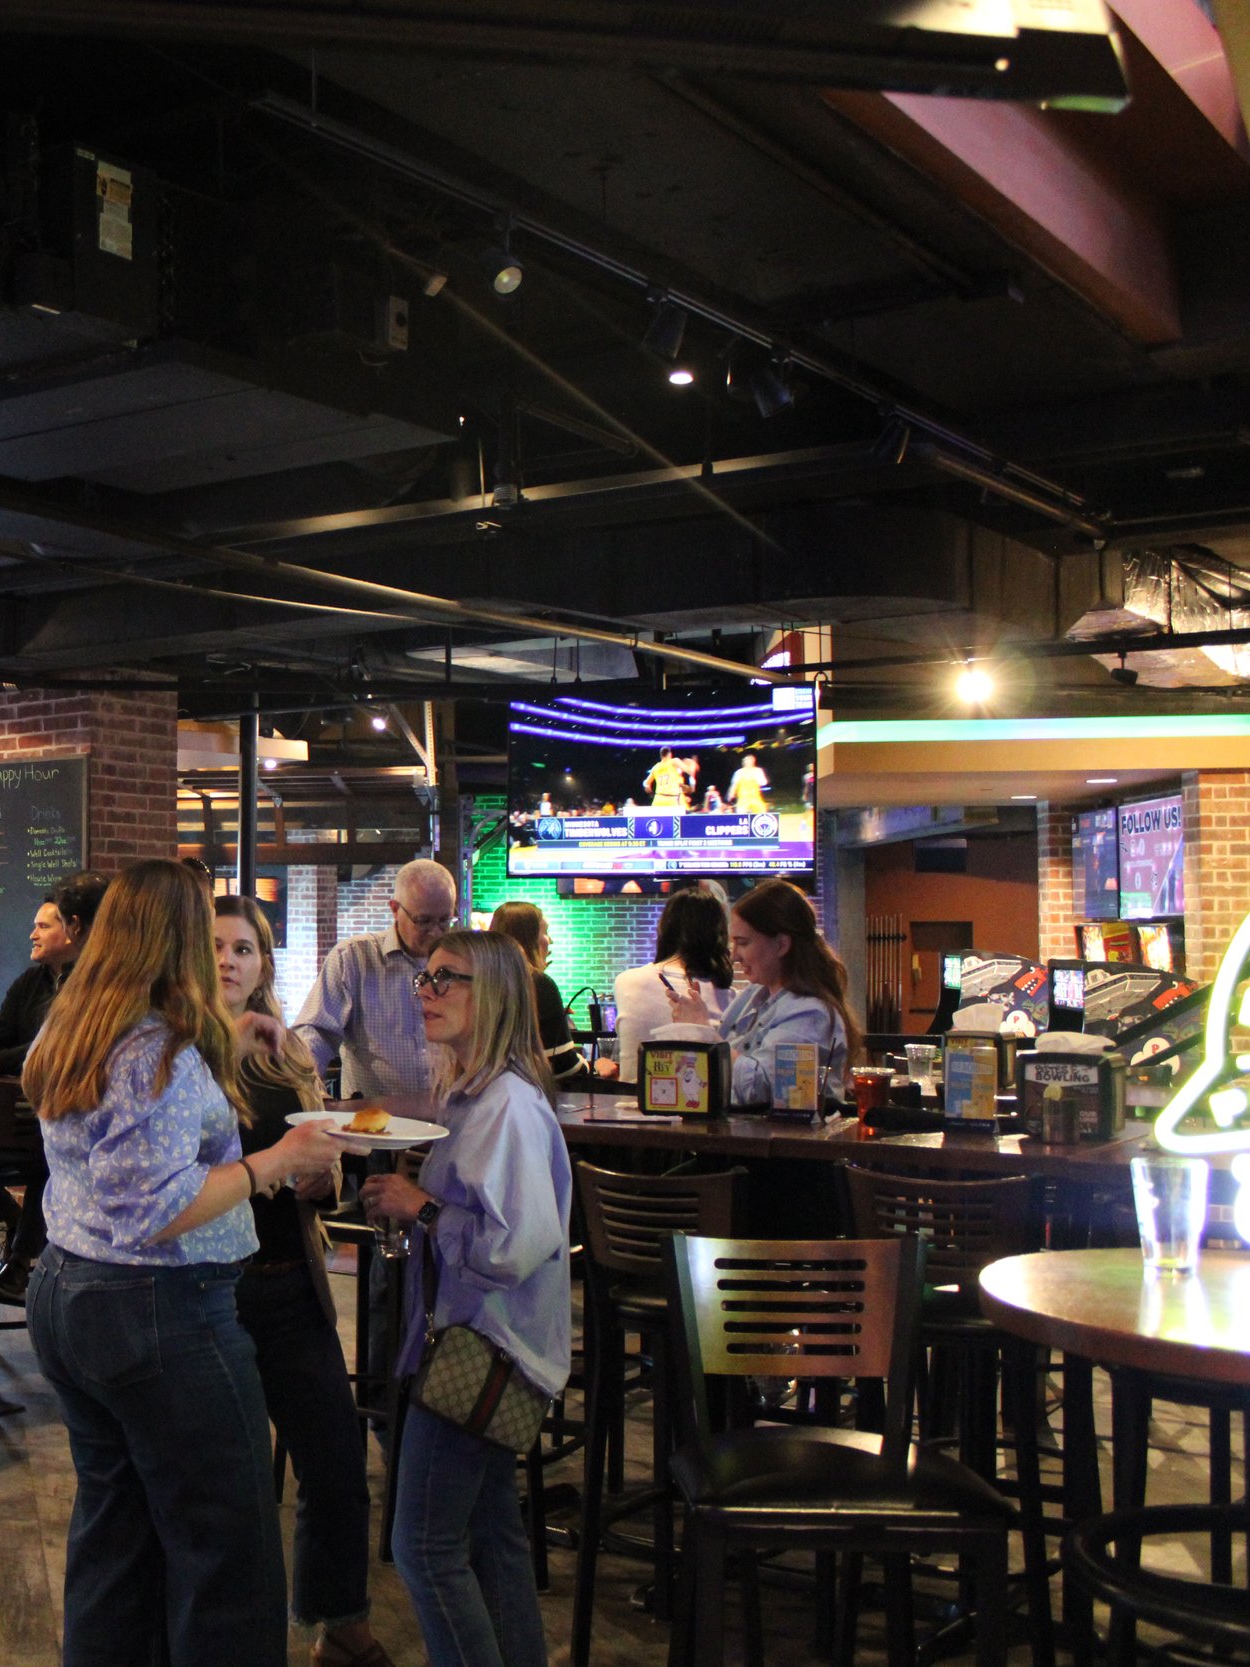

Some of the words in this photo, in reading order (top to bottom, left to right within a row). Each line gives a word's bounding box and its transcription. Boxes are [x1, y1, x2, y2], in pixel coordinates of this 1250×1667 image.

[24, 764, 60, 781] Hour
[30, 805, 62, 821] Drinks
[1121, 809, 1161, 834] FOLLOW
[1164, 805, 1182, 828] US!
[705, 825, 749, 836] CLIPPERS
[1013, 1015, 1020, 1023] P
[1035, 1072, 1091, 1083] BOWLING
